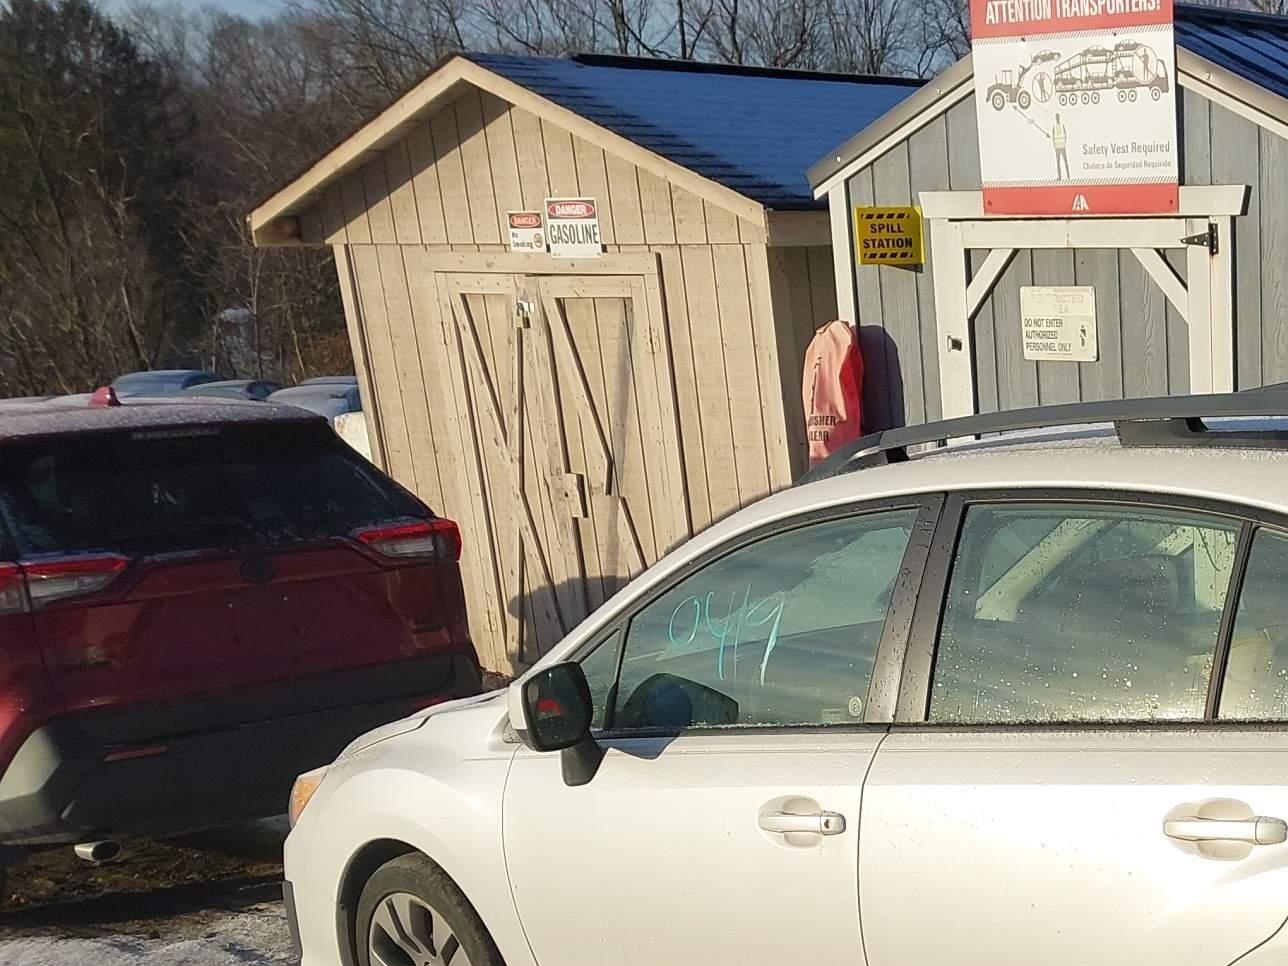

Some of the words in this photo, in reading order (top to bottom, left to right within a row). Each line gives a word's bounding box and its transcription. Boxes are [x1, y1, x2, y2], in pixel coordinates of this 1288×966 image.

[985, 0, 1051, 24] ATTENTION
[1082, 143, 1108, 157] Safety
[1110, 142, 1129, 154] Vest
[1131, 140, 1170, 156] Required
[554, 205, 587, 215] DANGER
[549, 224, 599, 244] GASOLINE
[869, 223, 905, 234] SPILL
[862, 238, 913, 249] STATION
[1024, 318, 1033, 328] DO
[1033, 318, 1045, 328] NOT
[1045, 318, 1063, 328] ENTER
[1025, 330, 1059, 340] AUTHORIZED
[1025, 341, 1057, 352] PERSONNEL
[1057, 342, 1072, 352] ONLY
